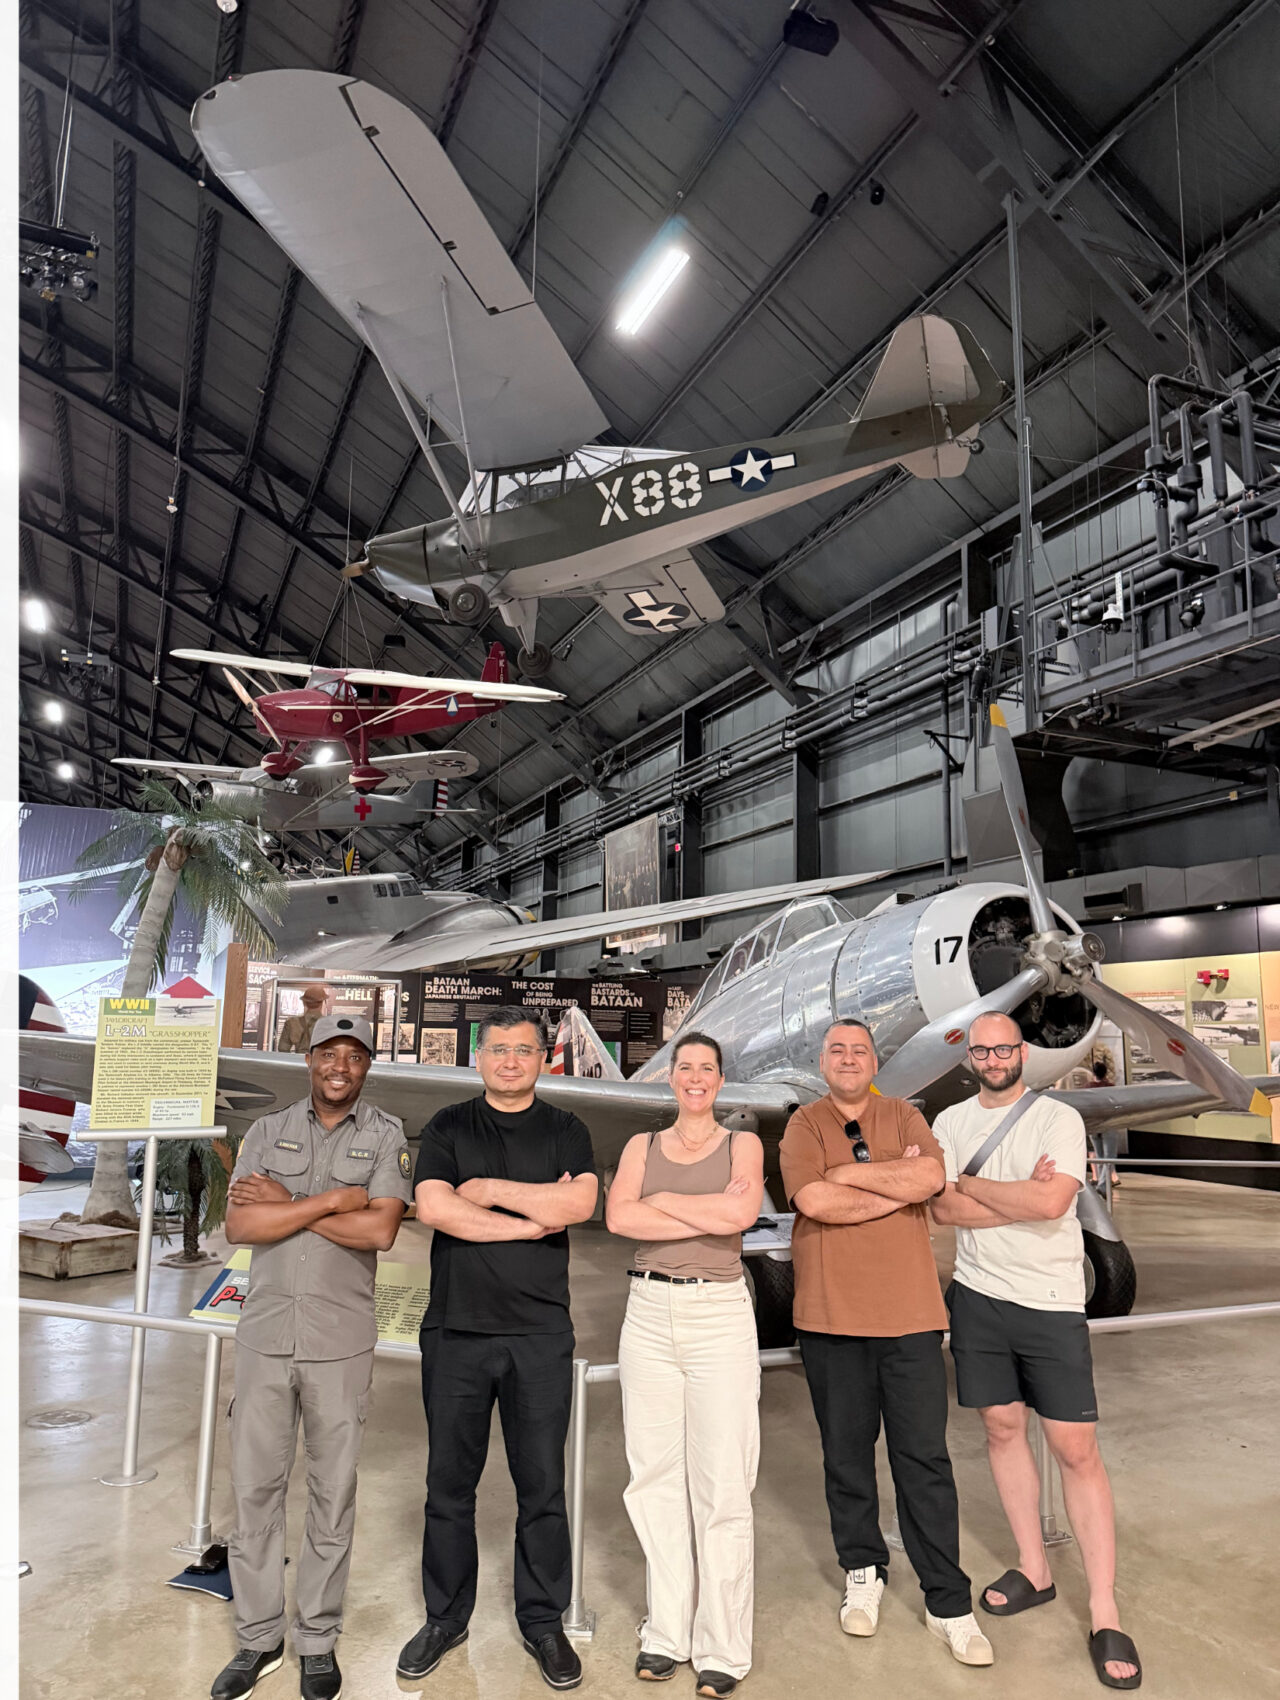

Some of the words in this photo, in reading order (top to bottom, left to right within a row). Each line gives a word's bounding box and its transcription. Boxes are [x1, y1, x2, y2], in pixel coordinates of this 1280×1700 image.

[595, 461, 702, 526] X88
[934, 936, 963, 965] 17
[433, 977, 470, 986] BATAAN
[511, 981, 528, 990] THE
[529, 981, 554, 991] COST
[345, 990, 372, 1000] HELL
[425, 985, 458, 994] DEATH
[460, 986, 503, 996] MARCH:
[591, 988, 630, 996] BASTARDS
[667, 990, 685, 998] DAYS
[109, 998, 150, 1010] WWII
[522, 997, 579, 1007] UNPREPARED
[591, 996, 643, 1008] BATAAN
[667, 997, 691, 1007] BATA
[105, 1024, 147, 1037] L-2M
